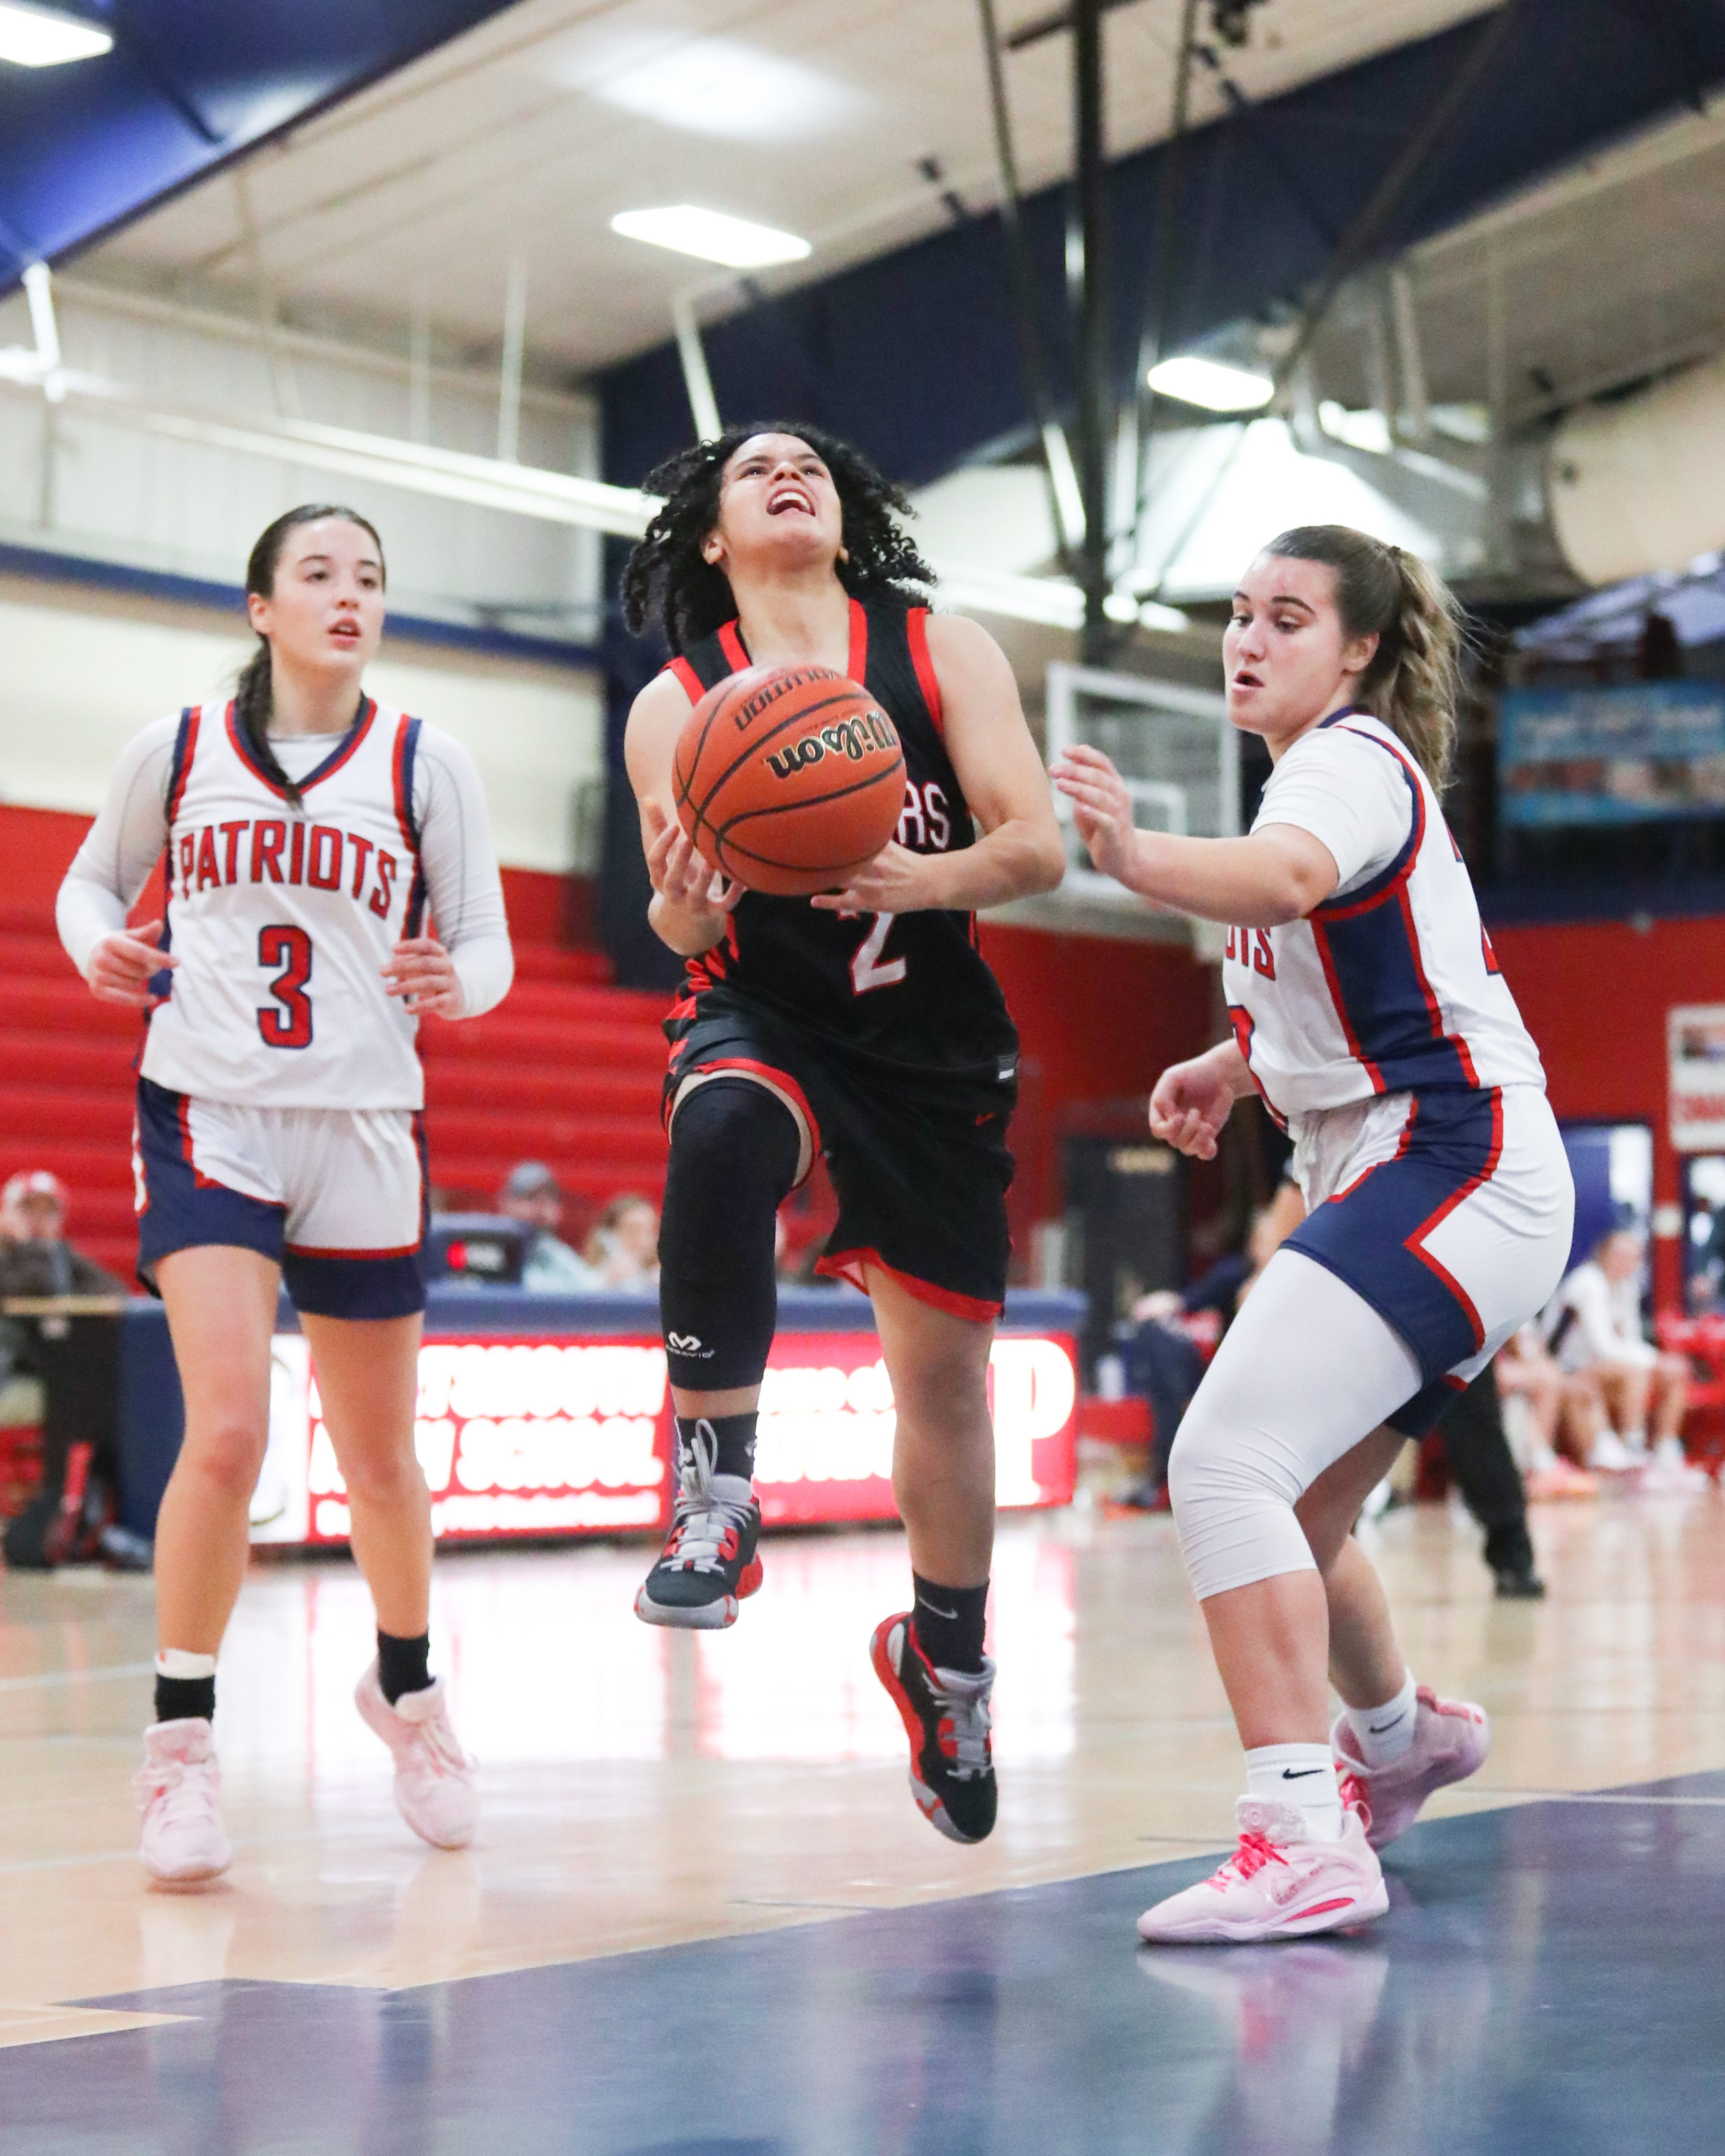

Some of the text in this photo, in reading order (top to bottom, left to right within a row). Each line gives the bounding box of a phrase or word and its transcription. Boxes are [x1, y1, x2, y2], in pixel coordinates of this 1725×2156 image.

[764, 710, 897, 779] Wilson
[180, 819, 396, 920] PATRIOTS
[257, 924, 313, 1049] 3
[837, 909, 907, 996] 2
